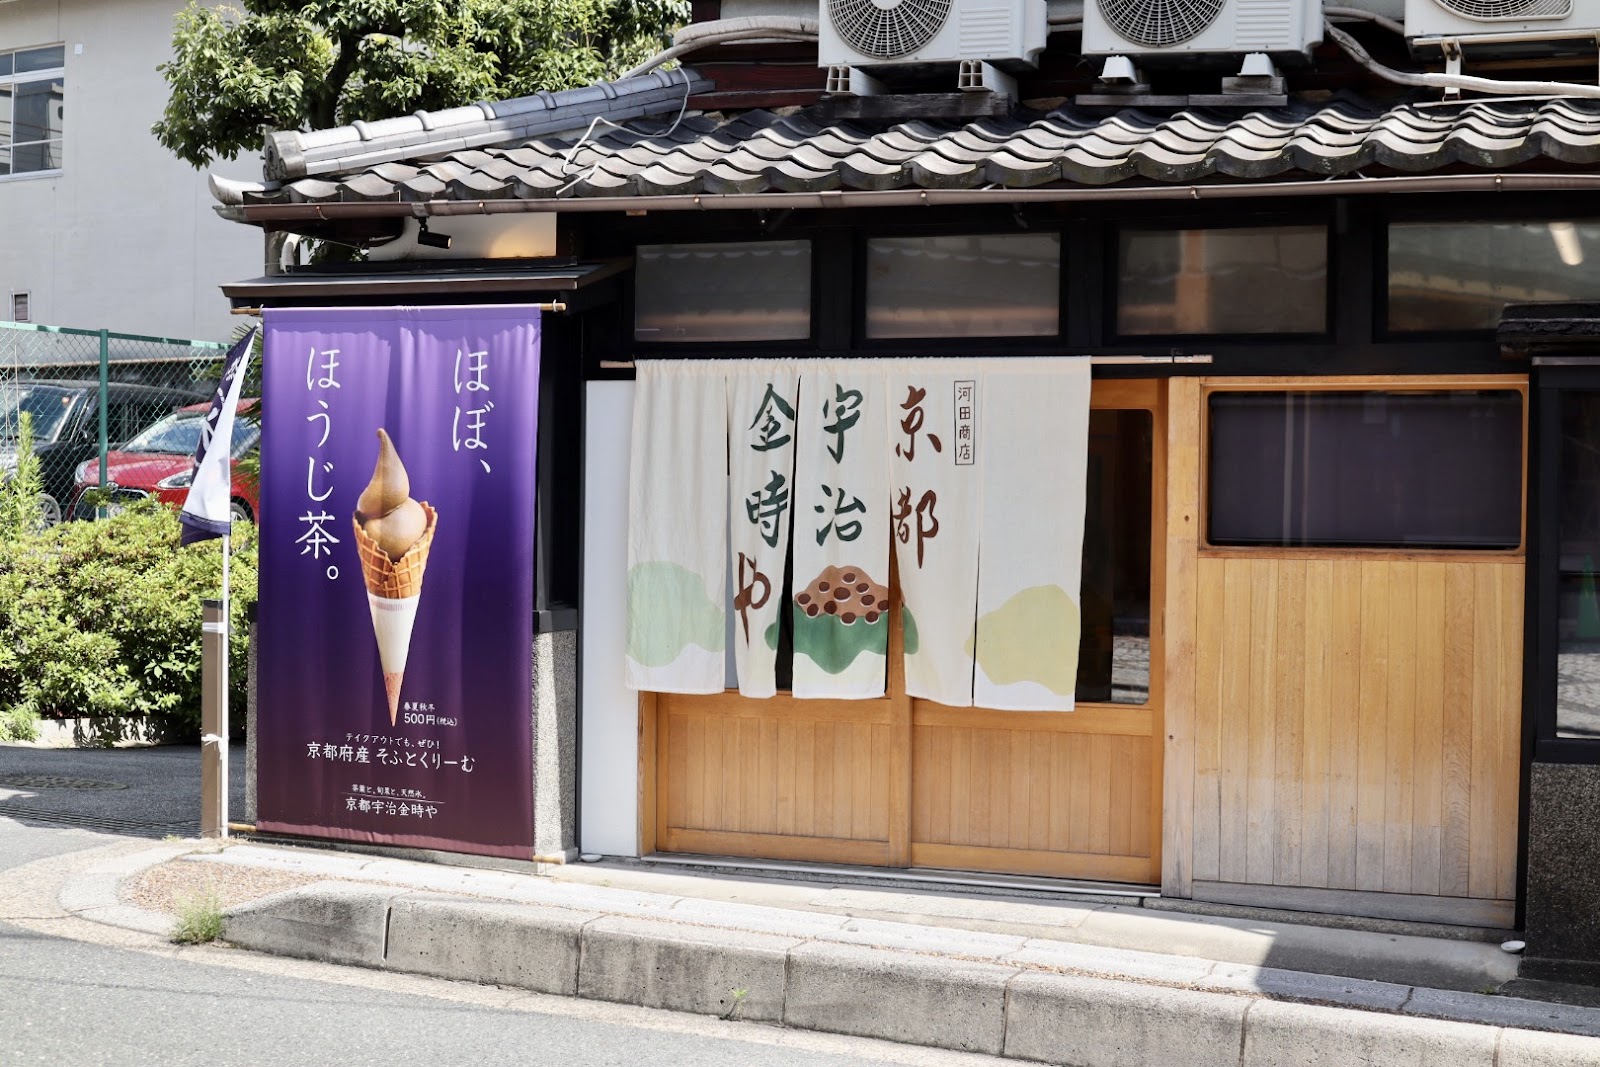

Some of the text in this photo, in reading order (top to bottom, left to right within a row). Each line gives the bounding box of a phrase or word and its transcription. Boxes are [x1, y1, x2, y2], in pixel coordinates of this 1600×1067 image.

[294, 346, 341, 580] ほうじ茶。
[452, 348, 495, 474] ほぼ、
[814, 383, 867, 547] 宇治
[893, 385, 942, 569] 京都
[957, 386, 973, 460] 河田商店
[733, 383, 795, 651] 金時や
[306, 741, 476, 773] 京都府産 そふとくりーむ
[345, 796, 438, 819] 京都宇治金時や
